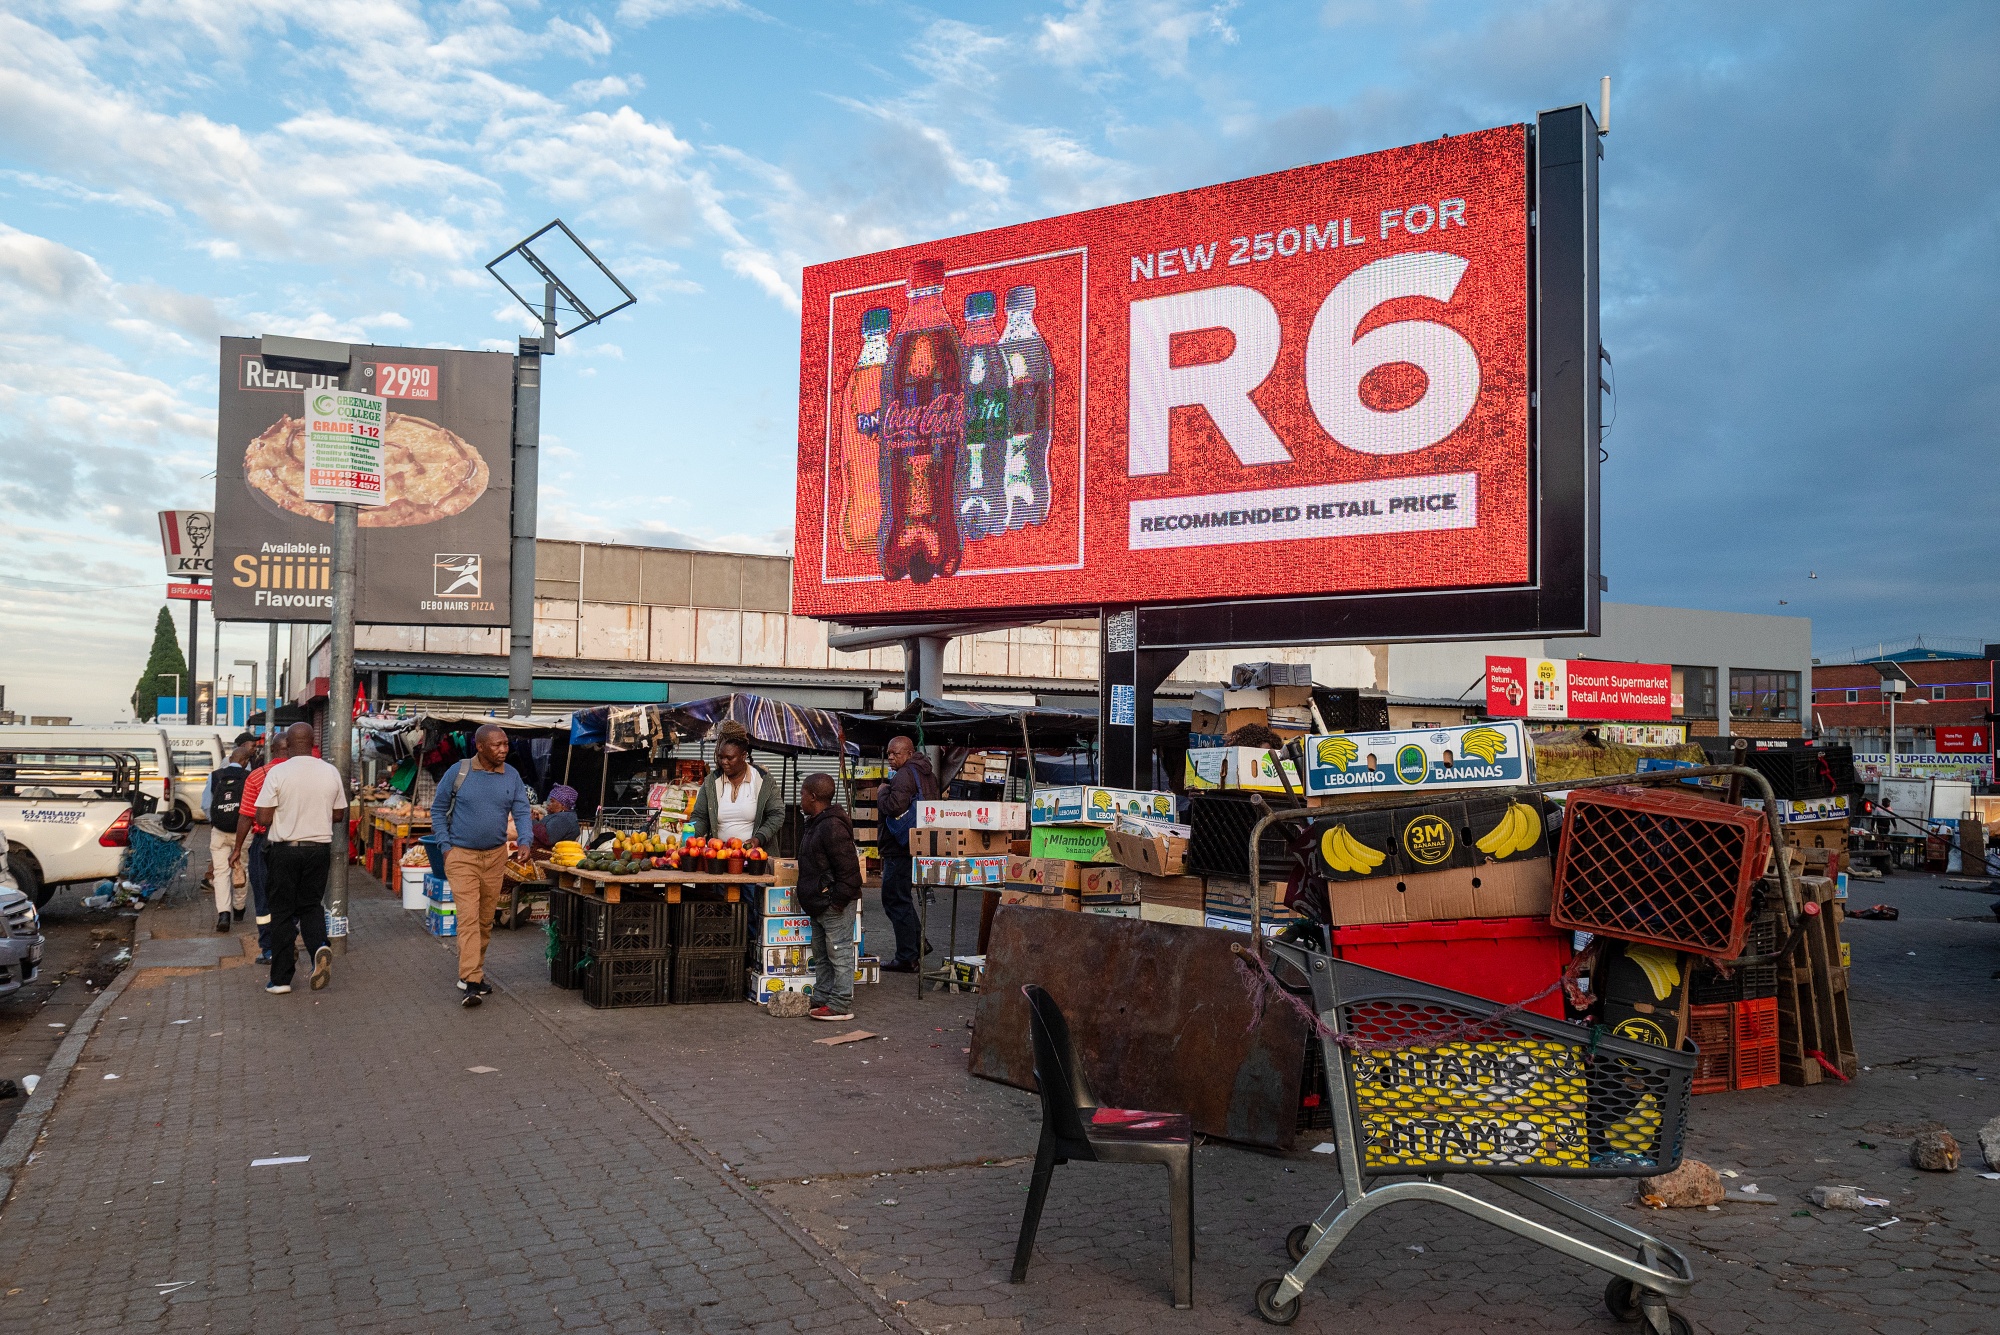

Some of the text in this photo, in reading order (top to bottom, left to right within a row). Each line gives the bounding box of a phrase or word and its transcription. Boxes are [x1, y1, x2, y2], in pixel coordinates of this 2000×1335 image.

[1130, 196, 1468, 282] NEW 250ML FOR
[1128, 251, 1482, 478] R6
[246, 360, 304, 389] REAL
[411, 388, 429, 398] EACH
[336, 395, 382, 411] GREENLANE
[337, 406, 381, 422] COLLEGE
[313, 420, 354, 434] GRADE
[358, 425, 380, 438] 1-12
[315, 449, 376, 460] Quality Education
[316, 443, 370, 453] Affordable Fees
[315, 455, 380, 467] Qualified Teachers
[335, 463, 374, 472] Curriculum
[337, 471, 358, 480] 492
[359, 474, 380, 483] 1778
[338, 480, 358, 488] 262
[358, 482, 380, 491] 4572
[1139, 492, 1457, 533] RECOMMENDED RETAIL PRICE
[260, 541, 331, 554] Available in
[177, 557, 214, 571] KFC
[232, 554, 333, 590] Siiiiii
[254, 590, 334, 608] Flavours
[471, 601, 495, 611] PIZZA
[1120, 613, 1128, 650] ABORTION
[1490, 665, 1513, 674] Refresh
[1491, 675, 1510, 683] Return
[1568, 673, 1669, 690] Discount Supermarket
[1491, 685, 1506, 693] Save
[1111, 685, 1119, 723] ABORTION
[1571, 690, 1667, 704] Retail And Wholesale
[1853, 754, 1887, 763] PLUS
[1324, 771, 1386, 786] LEBOMBO
[1434, 765, 1504, 780] BANANAS
[38, 810, 86, 818] MULAUDZI
[1411, 823, 1446, 844] 3M
[1413, 840, 1446, 849] BANANAS
